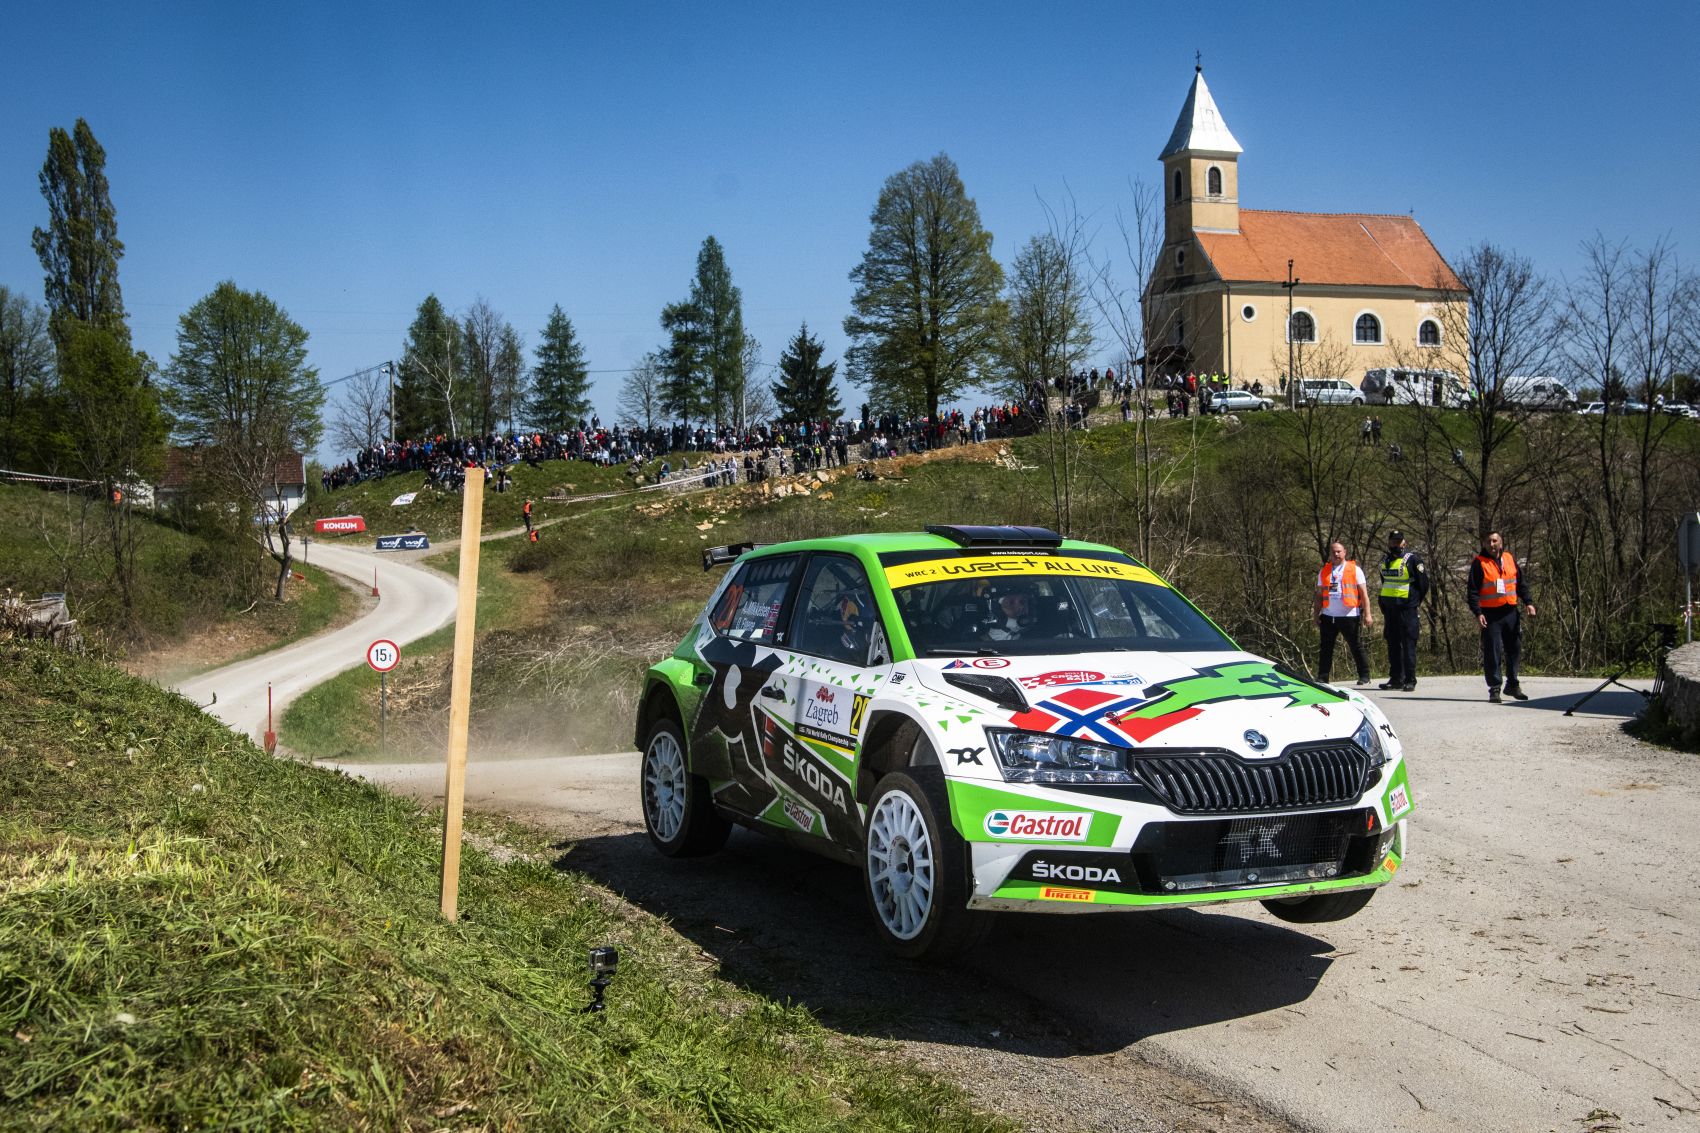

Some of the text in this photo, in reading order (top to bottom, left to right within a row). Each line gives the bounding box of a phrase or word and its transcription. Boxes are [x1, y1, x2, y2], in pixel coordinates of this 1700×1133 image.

[905, 569, 928, 578] WRC
[1045, 561, 1080, 572] ALL
[1081, 563, 1124, 576] LIVE
[375, 648, 387, 661] 15
[806, 699, 839, 726] Zagreb
[783, 740, 848, 815] ŠKODA
[789, 801, 813, 830] Castrol
[1010, 814, 1083, 837] Castrol
[1032, 860, 1121, 883] ŠKODA
[1045, 888, 1090, 900] PIRELLI
